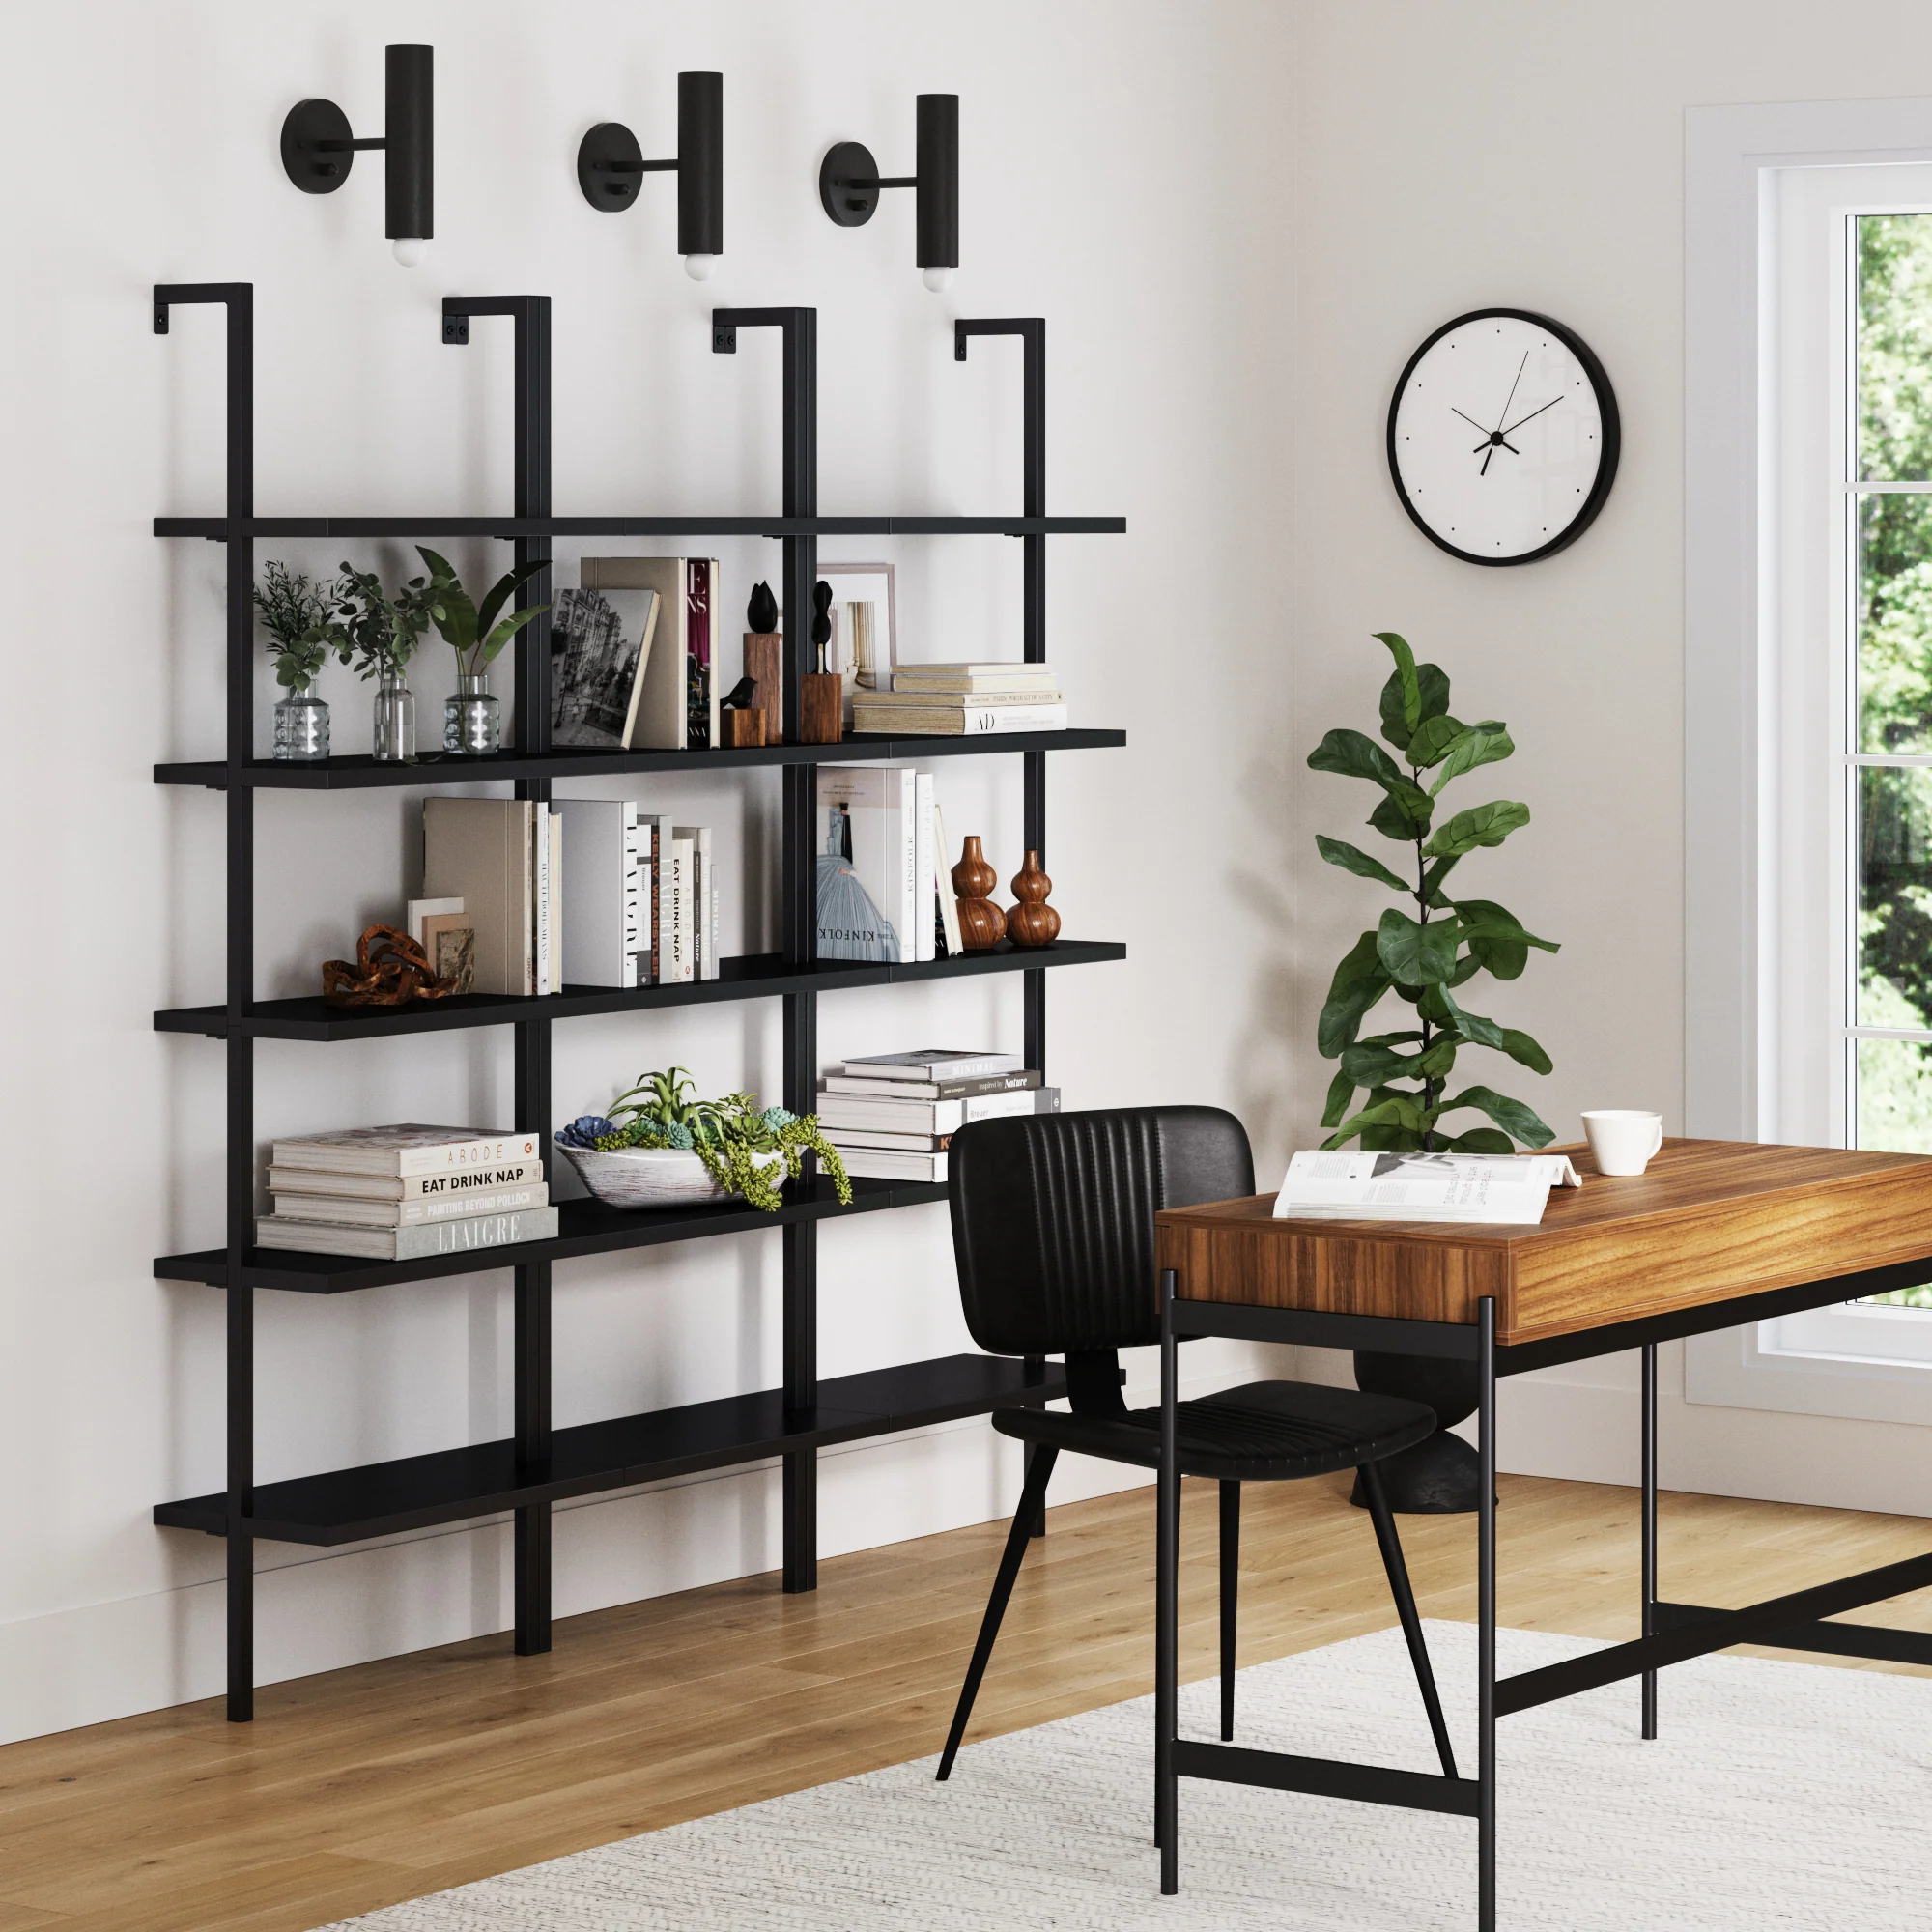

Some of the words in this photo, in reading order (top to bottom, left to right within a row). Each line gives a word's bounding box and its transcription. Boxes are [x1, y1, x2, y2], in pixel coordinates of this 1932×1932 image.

[975, 713, 995, 730] AD
[626, 826, 637, 966] LIAIGRE
[819, 928, 875, 942] KINFOLK
[952, 1062, 995, 1076] MINIMAL
[979, 1080, 998, 1091] Inspired
[1005, 1077, 1028, 1089] Nature
[970, 1109, 989, 1119] Breuer
[422, 1178, 446, 1194] EAT
[450, 1172, 492, 1190] DRINK
[496, 1168, 524, 1183] NAP
[427, 1199, 463, 1217] PAINTING
[465, 1195, 496, 1212] BEYOND
[497, 1191, 531, 1208] POLLOCK
[439, 1215, 521, 1253] LIAIGRE
